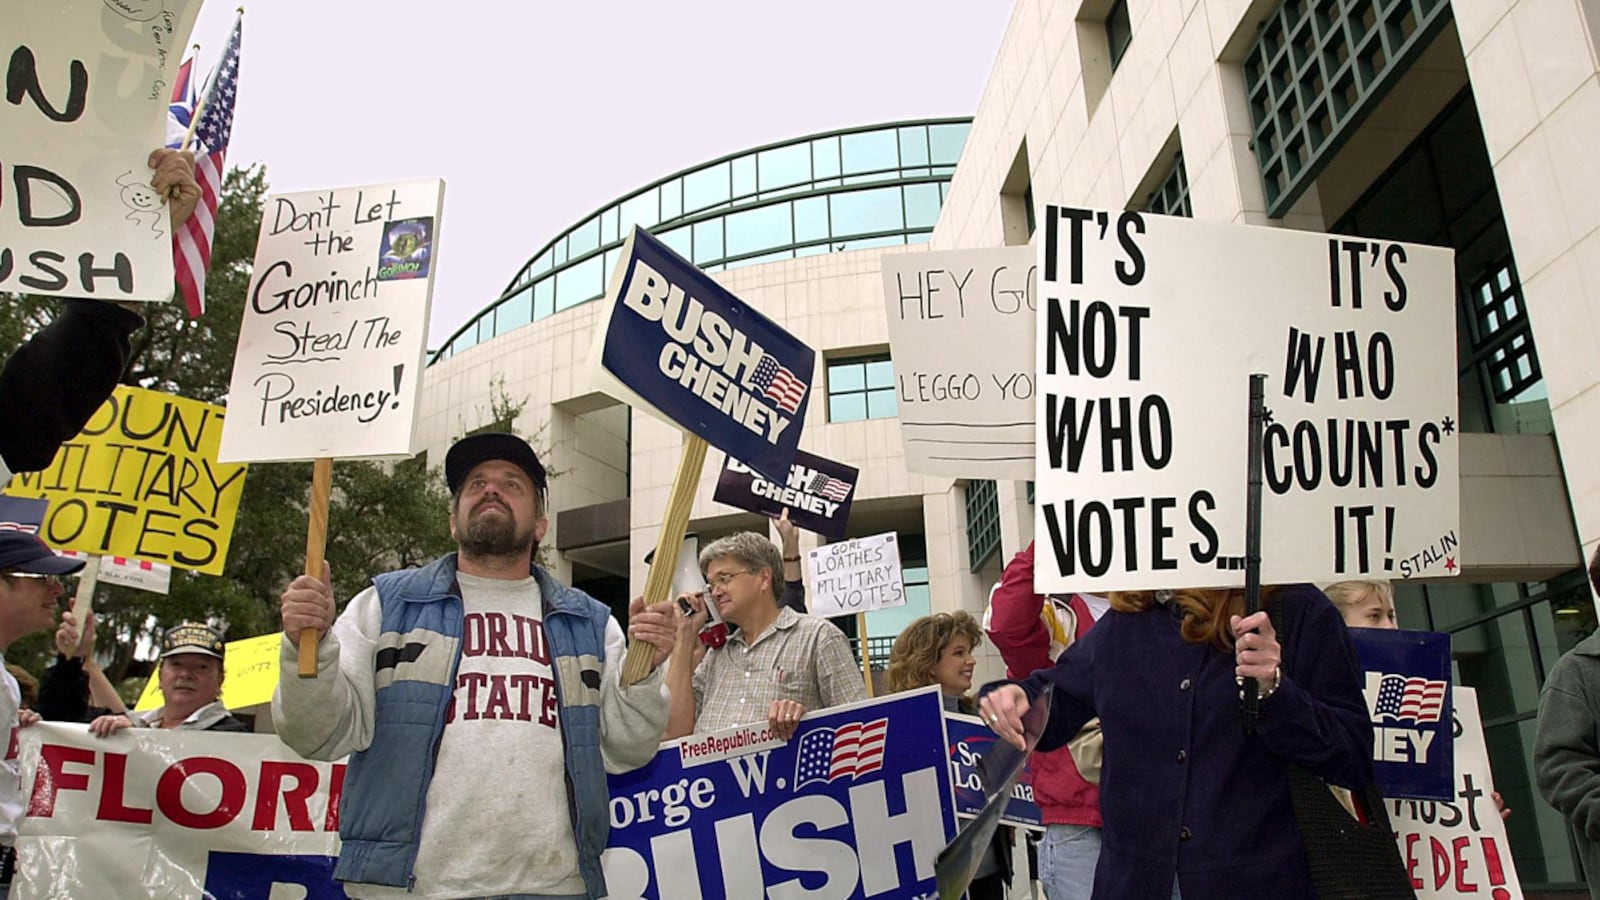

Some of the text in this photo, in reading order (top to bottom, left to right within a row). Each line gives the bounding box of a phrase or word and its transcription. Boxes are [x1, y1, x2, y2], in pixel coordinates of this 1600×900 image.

[0, 163, 82, 227] D
[268, 189, 402, 236] Don't Let
[304, 230, 354, 256] the
[1044, 204, 1146, 286] IT'S
[251, 261, 379, 315] Gorinch
[897, 268, 974, 320] HEY
[1328, 238, 1408, 312] IT'S
[267, 316, 402, 360] Steal The
[623, 258, 765, 392] BUSH
[1046, 297, 1150, 381] NOT
[991, 372, 1036, 401] YO
[1282, 325, 1395, 404] WHO
[253, 363, 405, 427] Presidency!
[658, 341, 791, 446] CHENEY
[1045, 393, 1173, 473] WHO
[750, 478, 840, 518] CHENEY
[40, 498, 220, 567] OTES
[832, 541, 862, 555] GORE
[1333, 505, 1396, 575] IT!
[1399, 530, 1459, 579] STALIN
[817, 546, 883, 575] LOATHES
[817, 564, 893, 595] MILITARY
[833, 580, 902, 609] VOTES
[681, 727, 780, 759] FreeRepublic.co
[726, 750, 787, 798] W.
[1393, 832, 1511, 900] EDE!
